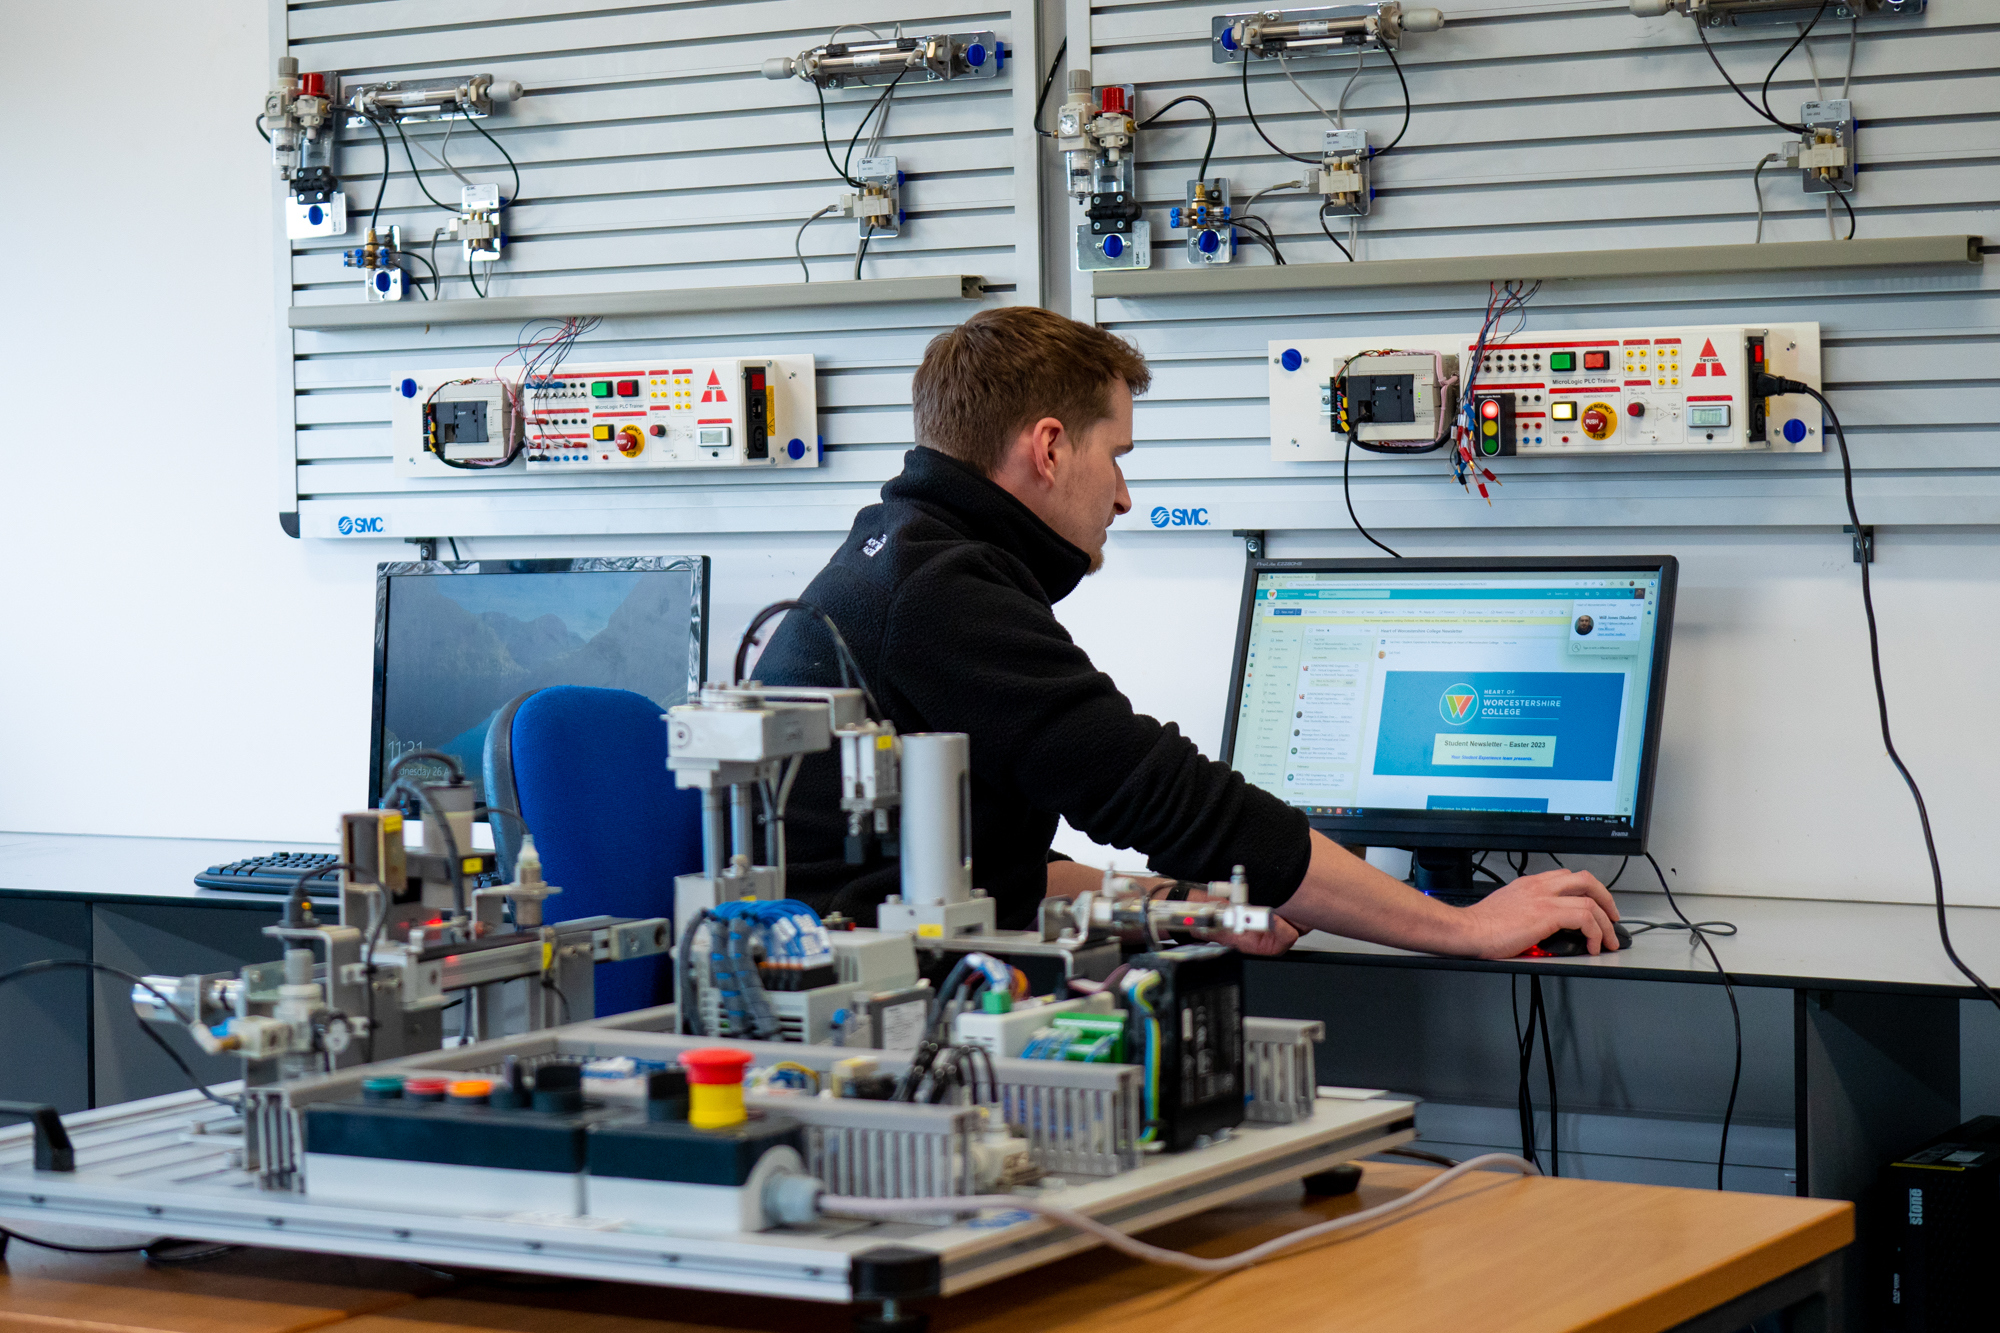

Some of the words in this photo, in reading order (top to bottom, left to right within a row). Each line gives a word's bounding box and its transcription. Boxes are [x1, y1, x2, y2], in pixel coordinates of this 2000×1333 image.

[1592, 432, 1606, 440] STOP
[1171, 508, 1208, 526] SMC
[354, 517, 384, 533] SMC
[1483, 699, 1561, 707] WORCESTERSHIRE
[1482, 708, 1521, 716] COLLEGE
[1470, 740, 1502, 748] Newsletter
[399, 767, 430, 778] dnesday
[432, 767, 442, 776] 26
[1909, 1188, 1922, 1225] stone
